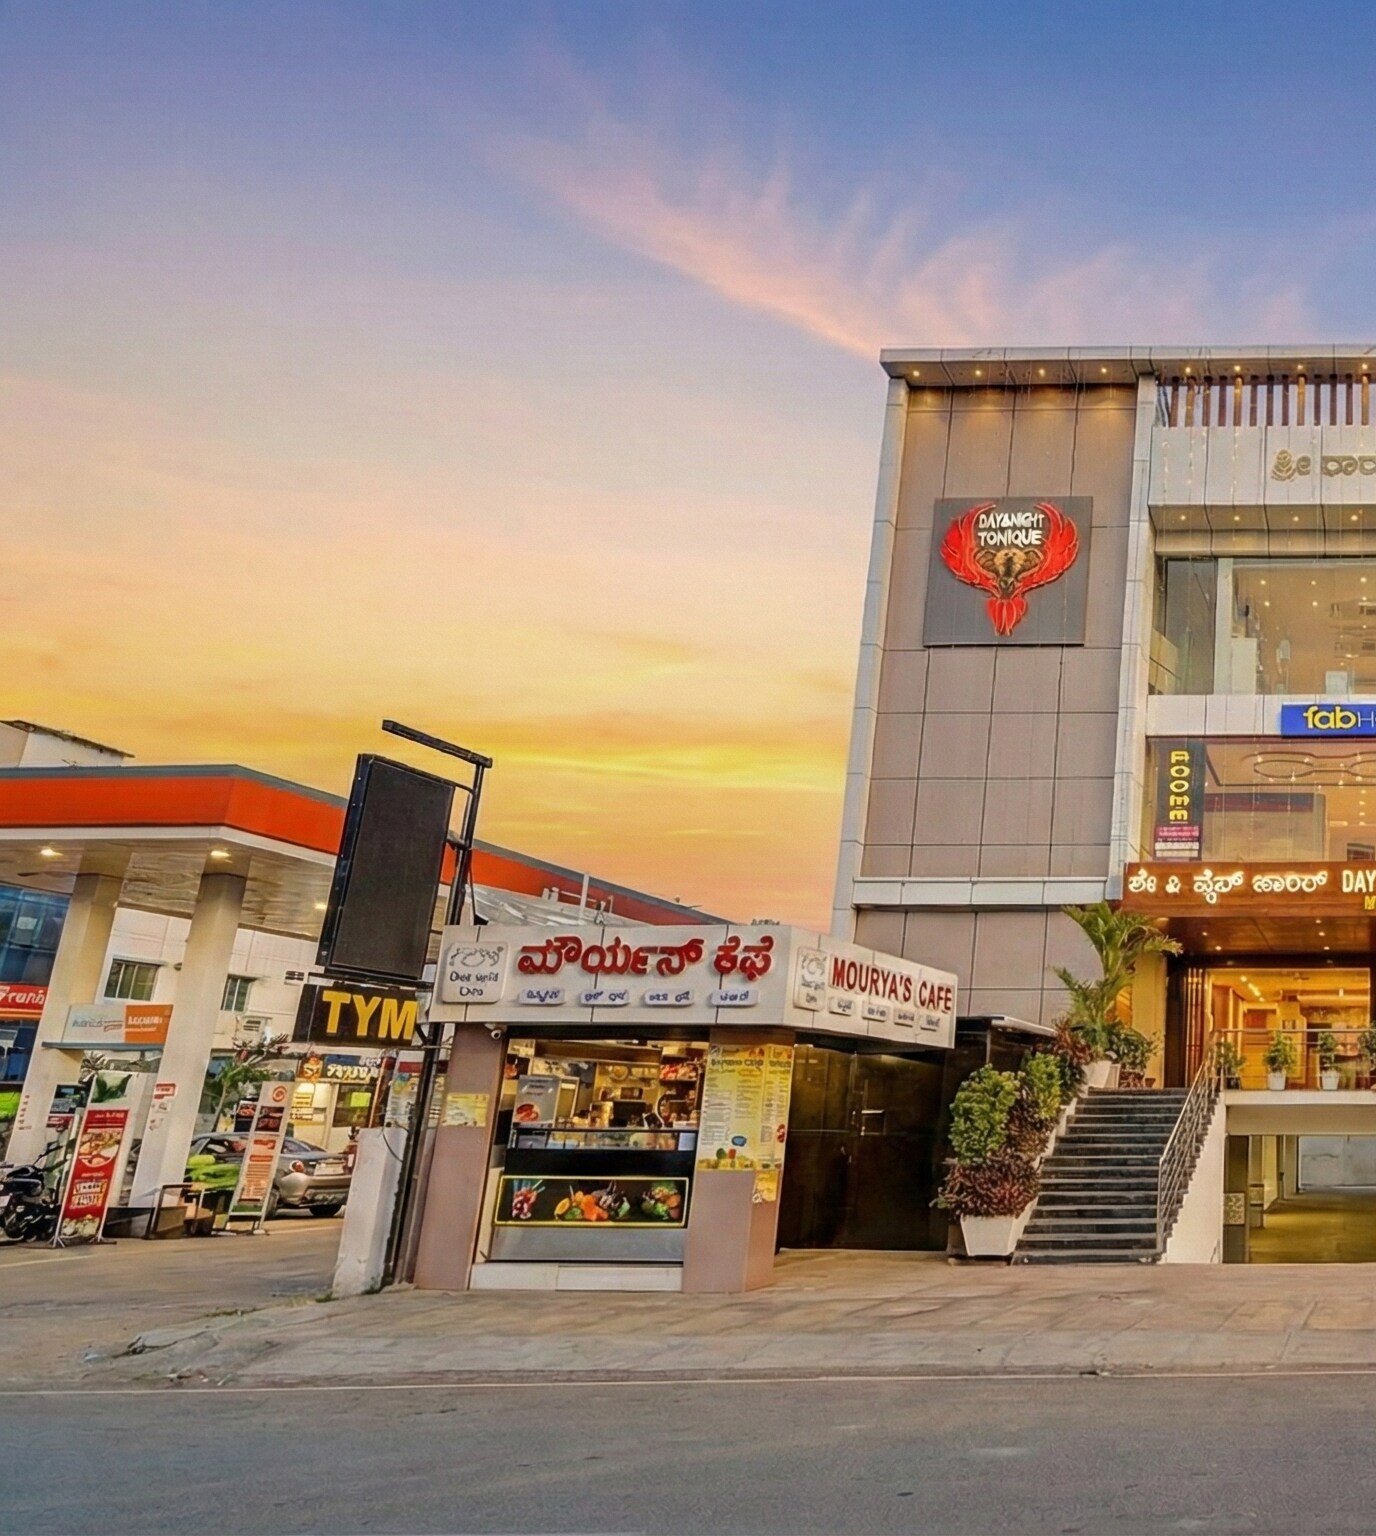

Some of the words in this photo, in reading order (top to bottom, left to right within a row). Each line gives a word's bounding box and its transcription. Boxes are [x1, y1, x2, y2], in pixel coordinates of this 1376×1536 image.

[978, 529, 1042, 547] TONIQUE
[1342, 870, 1376, 893] DAY
[832, 957, 912, 1002] MOURYA'S
[918, 980, 952, 1011] CAFE
[322, 990, 418, 1039] TYM
